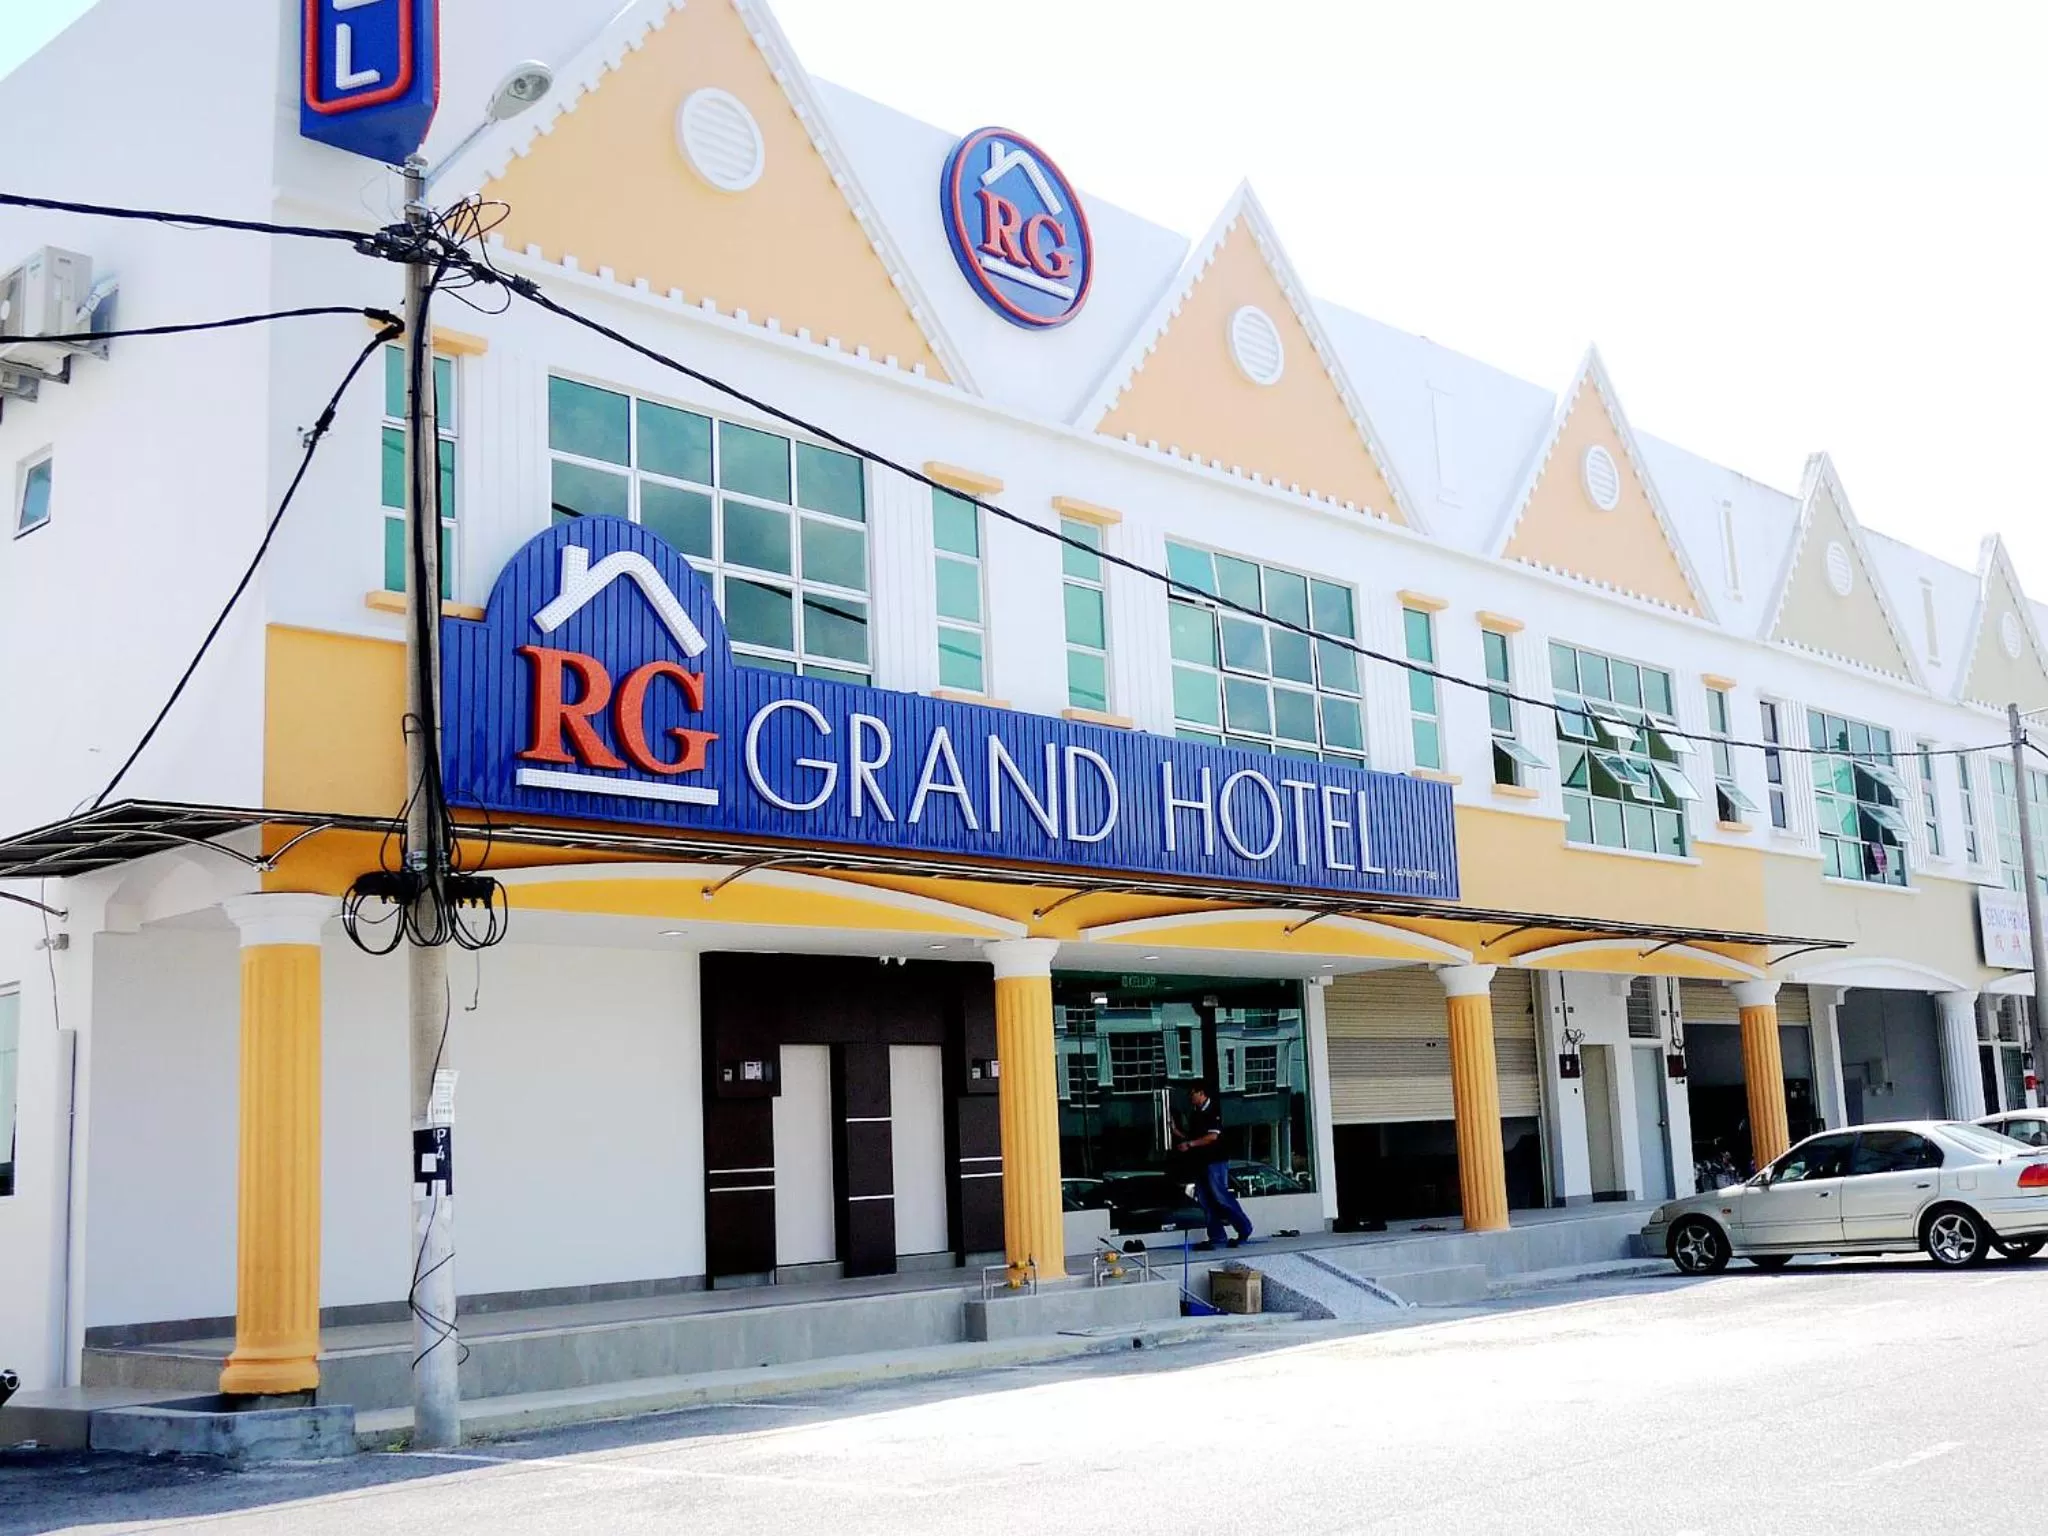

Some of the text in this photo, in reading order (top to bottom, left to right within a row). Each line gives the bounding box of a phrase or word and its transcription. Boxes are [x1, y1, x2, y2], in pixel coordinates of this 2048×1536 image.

[974, 187, 1073, 279] RG
[516, 645, 1386, 874] RG GRAND HOTEL
